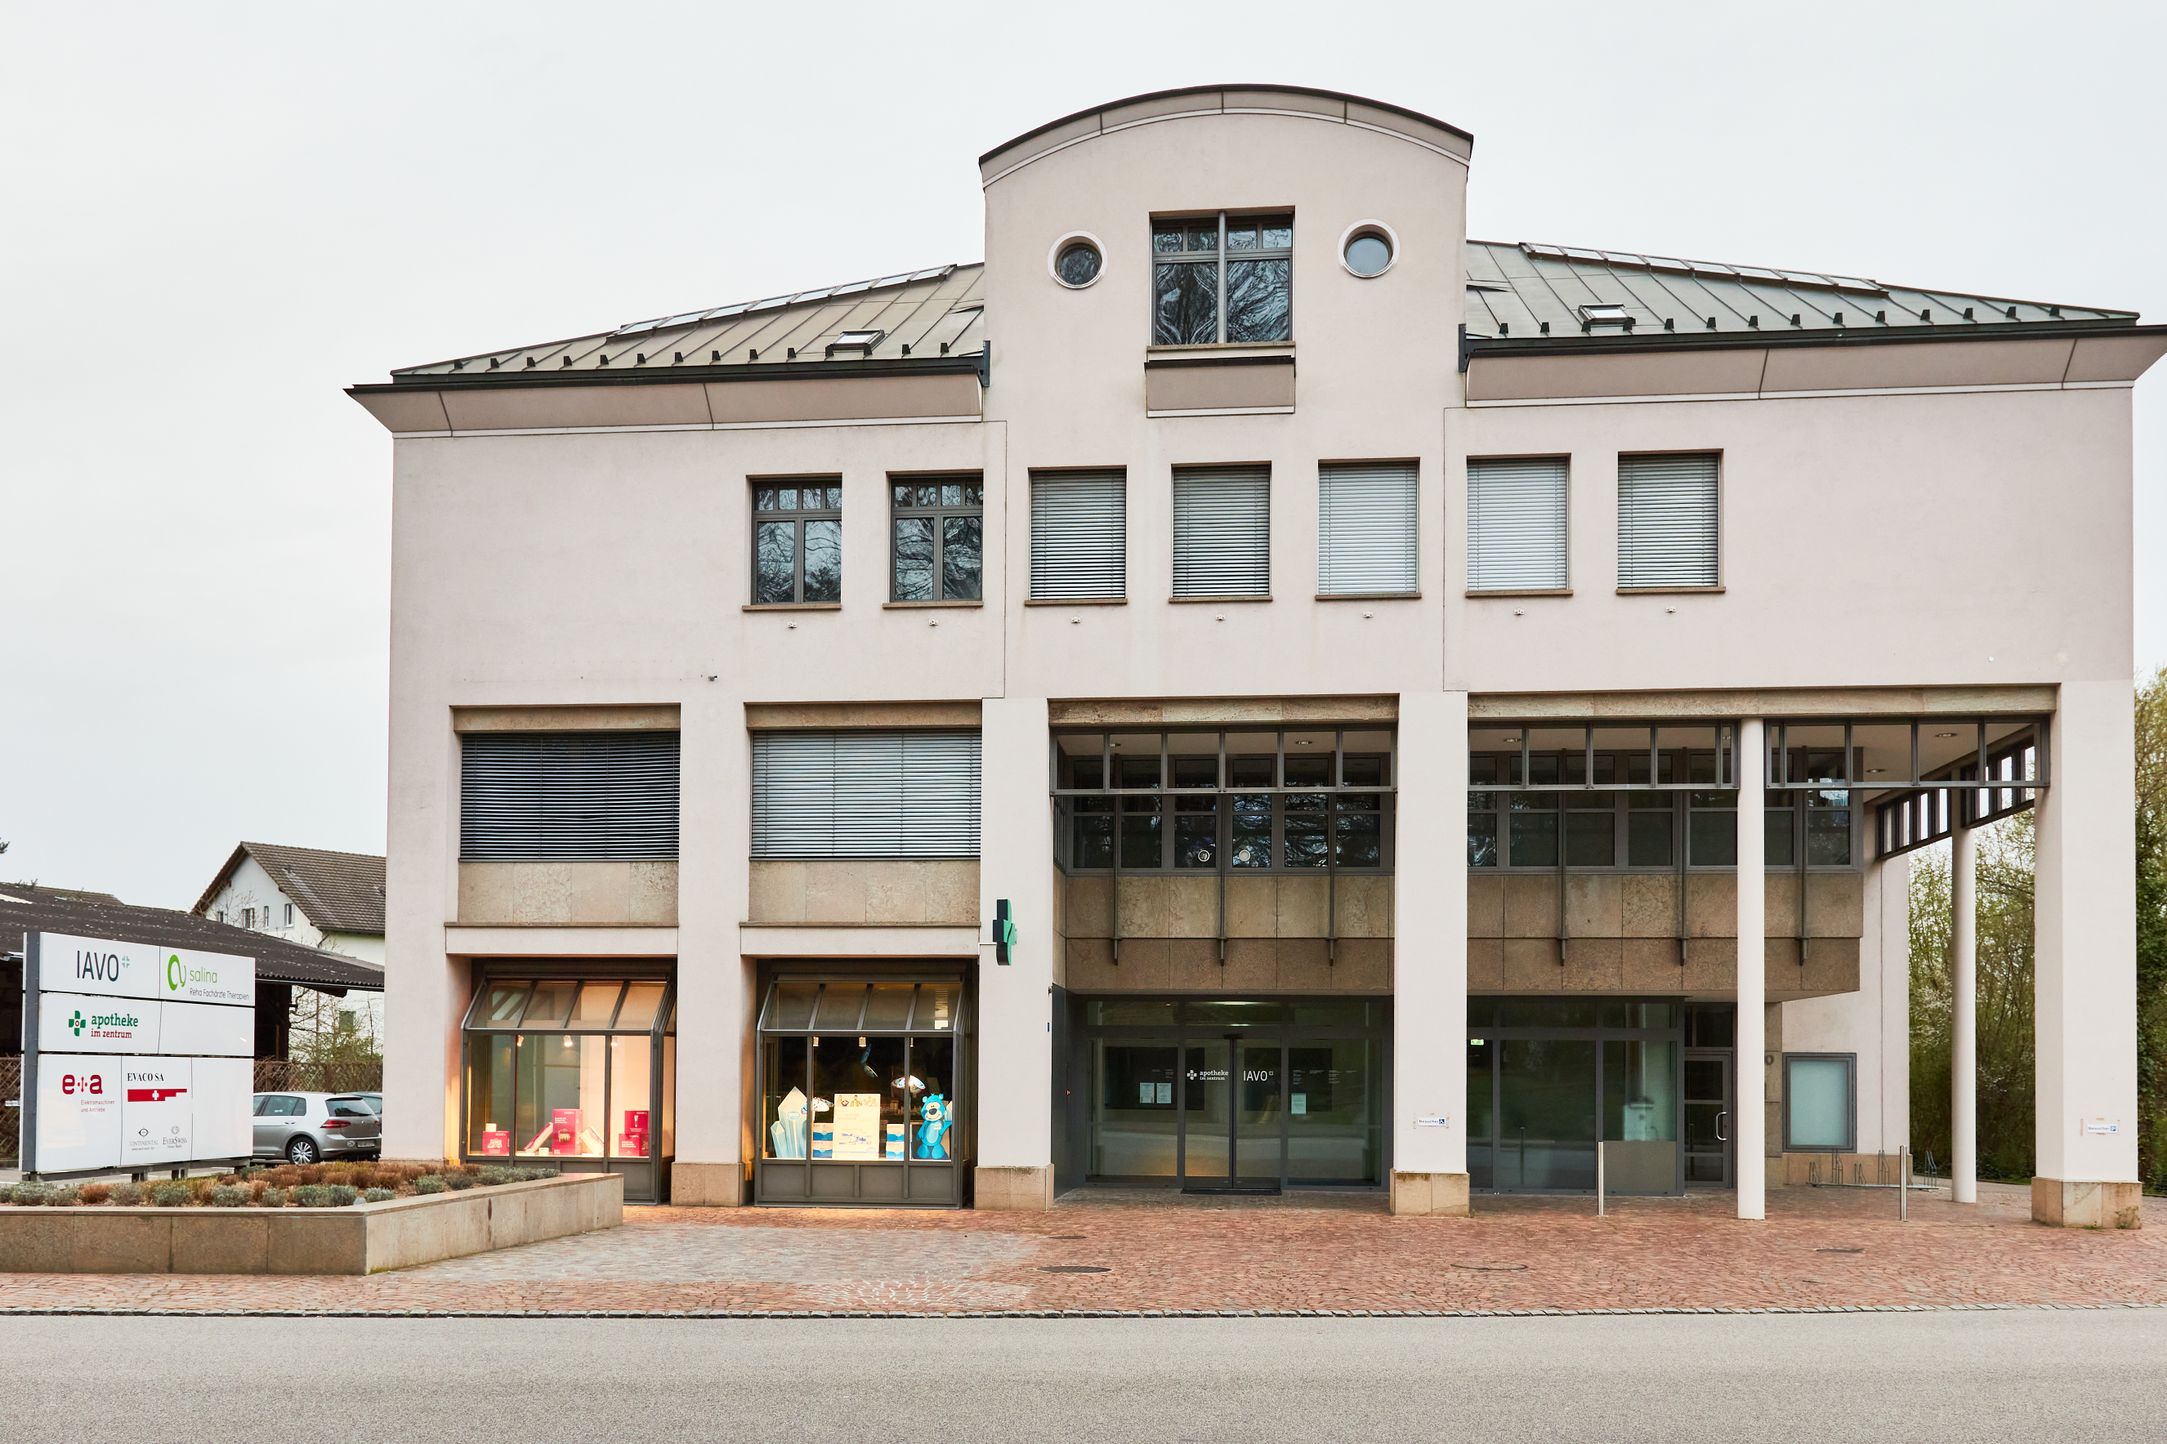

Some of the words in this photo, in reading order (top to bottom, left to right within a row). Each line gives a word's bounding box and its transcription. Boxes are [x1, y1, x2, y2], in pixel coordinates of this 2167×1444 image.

[77, 950, 119, 982] IAVO
[190, 966, 218, 983] salina
[190, 987, 202, 997] Reha
[91, 1012, 139, 1029] apotheke
[91, 1028, 101, 1038] im
[102, 1029, 133, 1039] zentrum
[127, 1072, 154, 1082] EVACO
[155, 1073, 165, 1082] SA
[1243, 1070, 1268, 1082] IAVO
